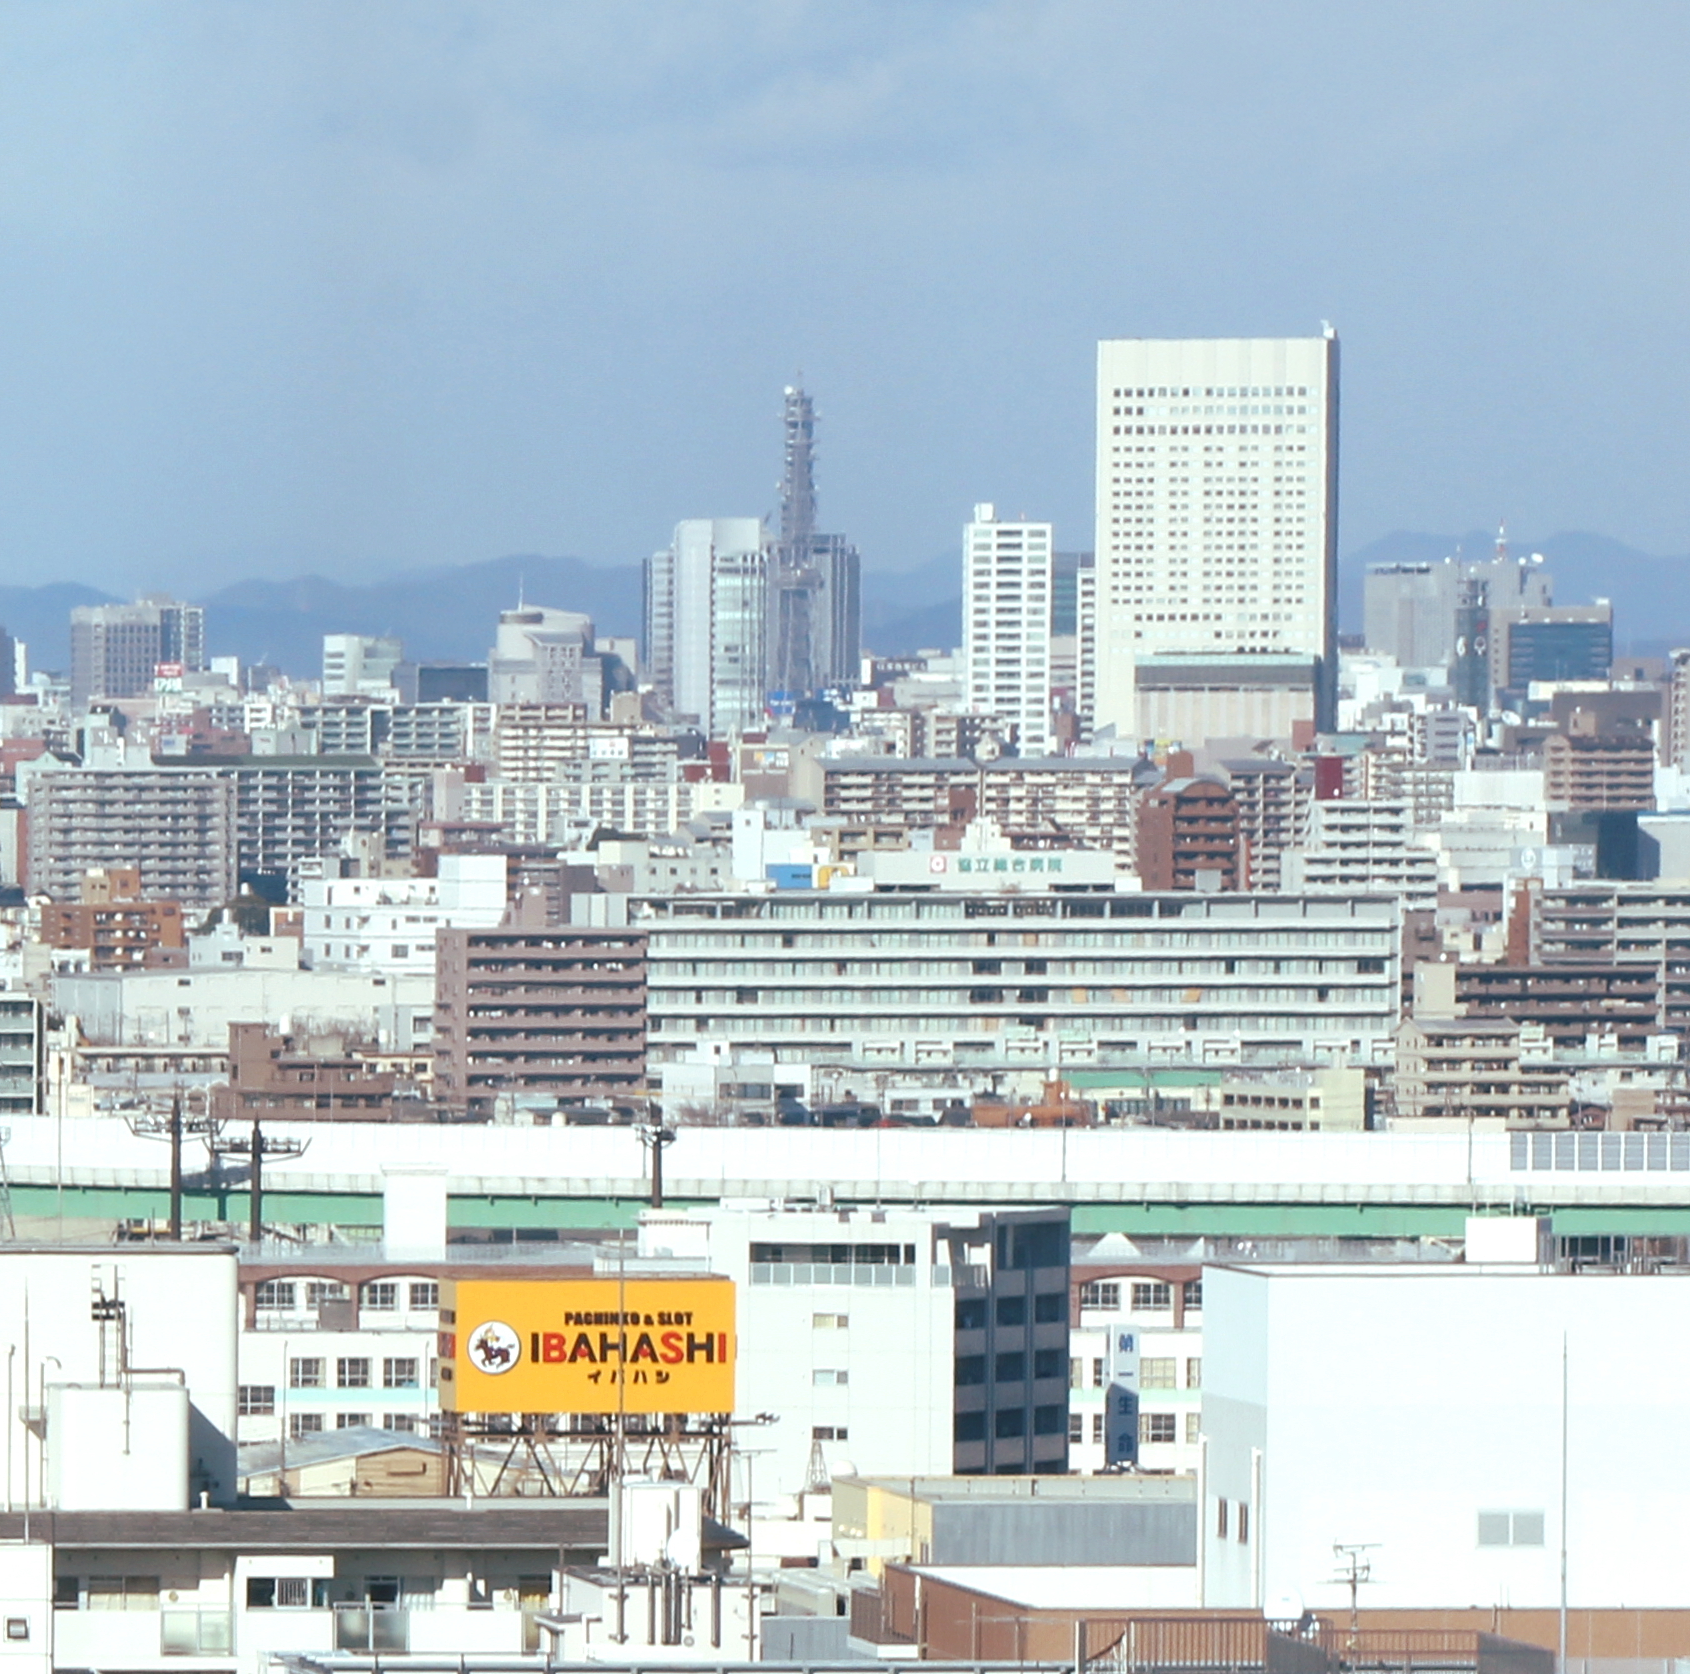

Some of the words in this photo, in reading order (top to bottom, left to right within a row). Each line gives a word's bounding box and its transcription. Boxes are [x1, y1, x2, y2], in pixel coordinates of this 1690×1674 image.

[564, 1311, 641, 1326] PACHINKO
[644, 1314, 654, 1326] &
[657, 1311, 693, 1326] SLOT
[530, 1330, 728, 1364] IBAHASHI
